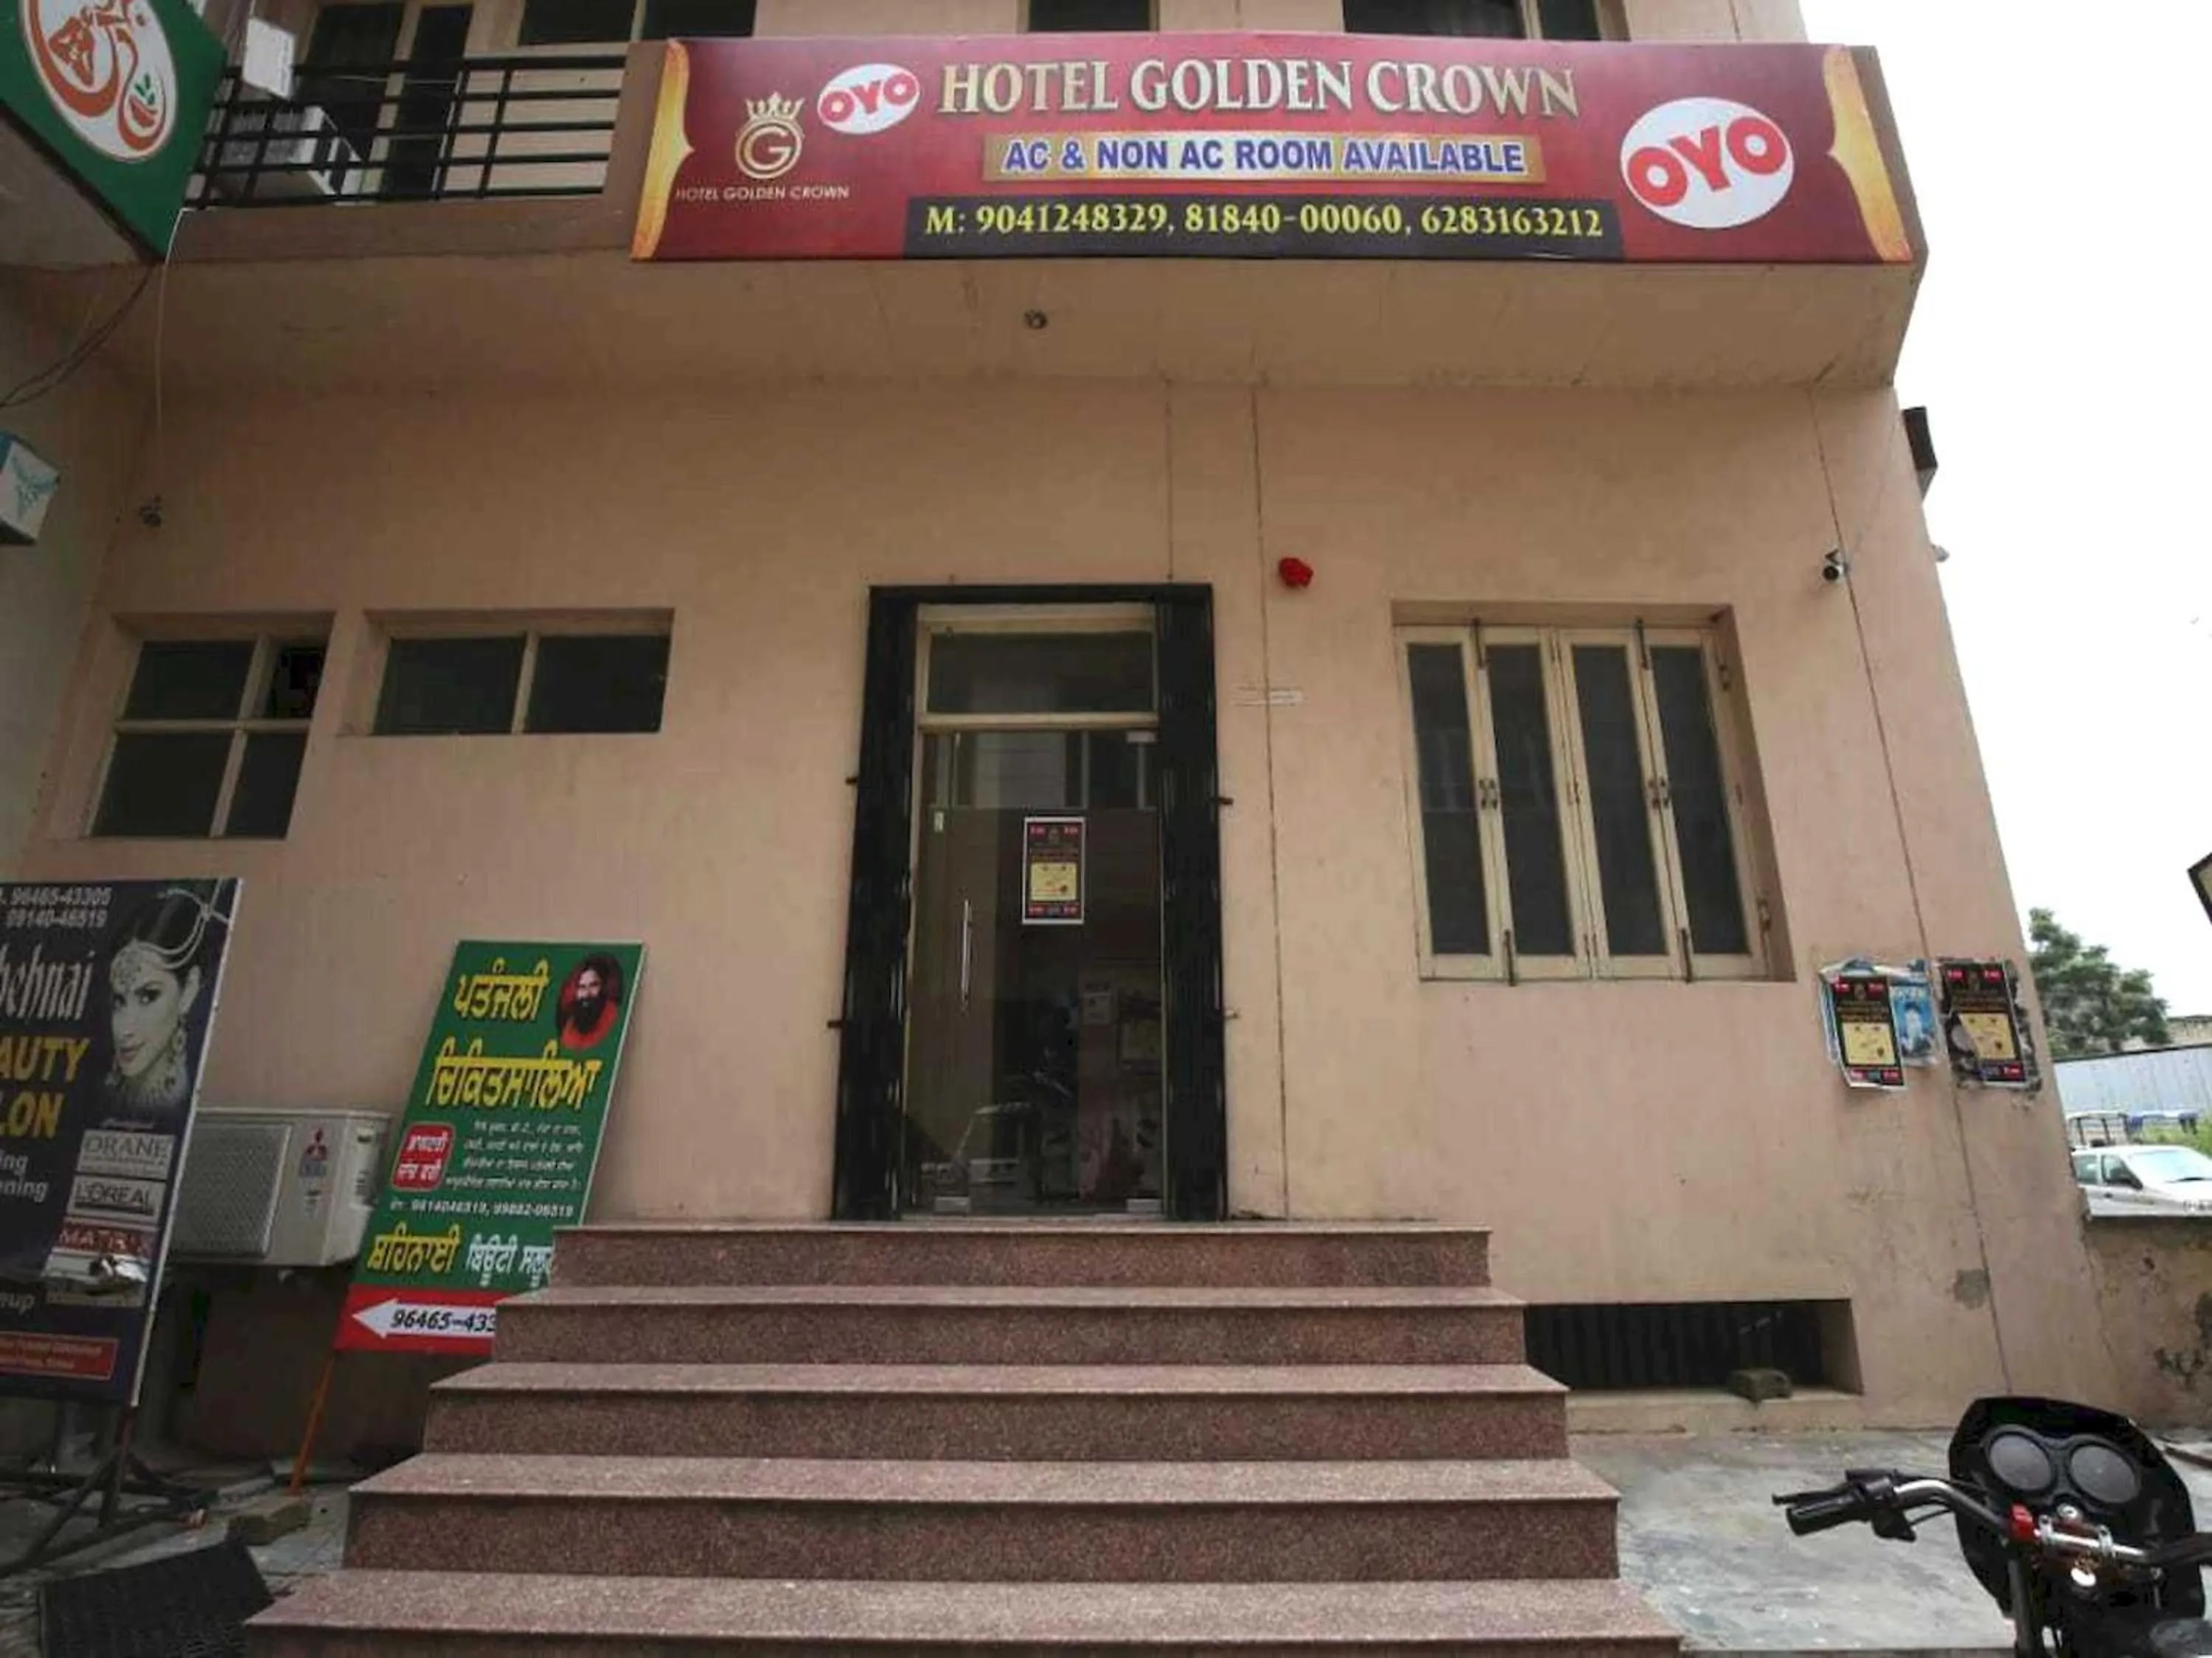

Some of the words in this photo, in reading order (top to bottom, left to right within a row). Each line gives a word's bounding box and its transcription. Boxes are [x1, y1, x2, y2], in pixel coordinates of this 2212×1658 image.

[820, 74, 918, 123] OYO
[938, 62, 1119, 113] HOTEL
[1130, 59, 1352, 111] GOLDEN
[1367, 60, 1579, 118] CROWN
[1006, 142, 1048, 170] AC
[1062, 141, 1085, 169] &
[1098, 140, 1168, 169] NON
[1180, 140, 1222, 169] AC
[1235, 140, 1332, 169] ROOM
[1343, 142, 1524, 172] AVAILABLE
[1627, 116, 1787, 207] OYO
[676, 187, 718, 201] HOTEL
[723, 186, 786, 200] GOLDEN
[790, 184, 849, 199] CROWN
[925, 206, 966, 235] M:
[975, 204, 1175, 235] 9041248329,
[1184, 204, 1411, 235] 81840-00060,
[1421, 206, 1603, 237] 6283163212
[518, 1246, 553, 1288] ਸਲੂ
